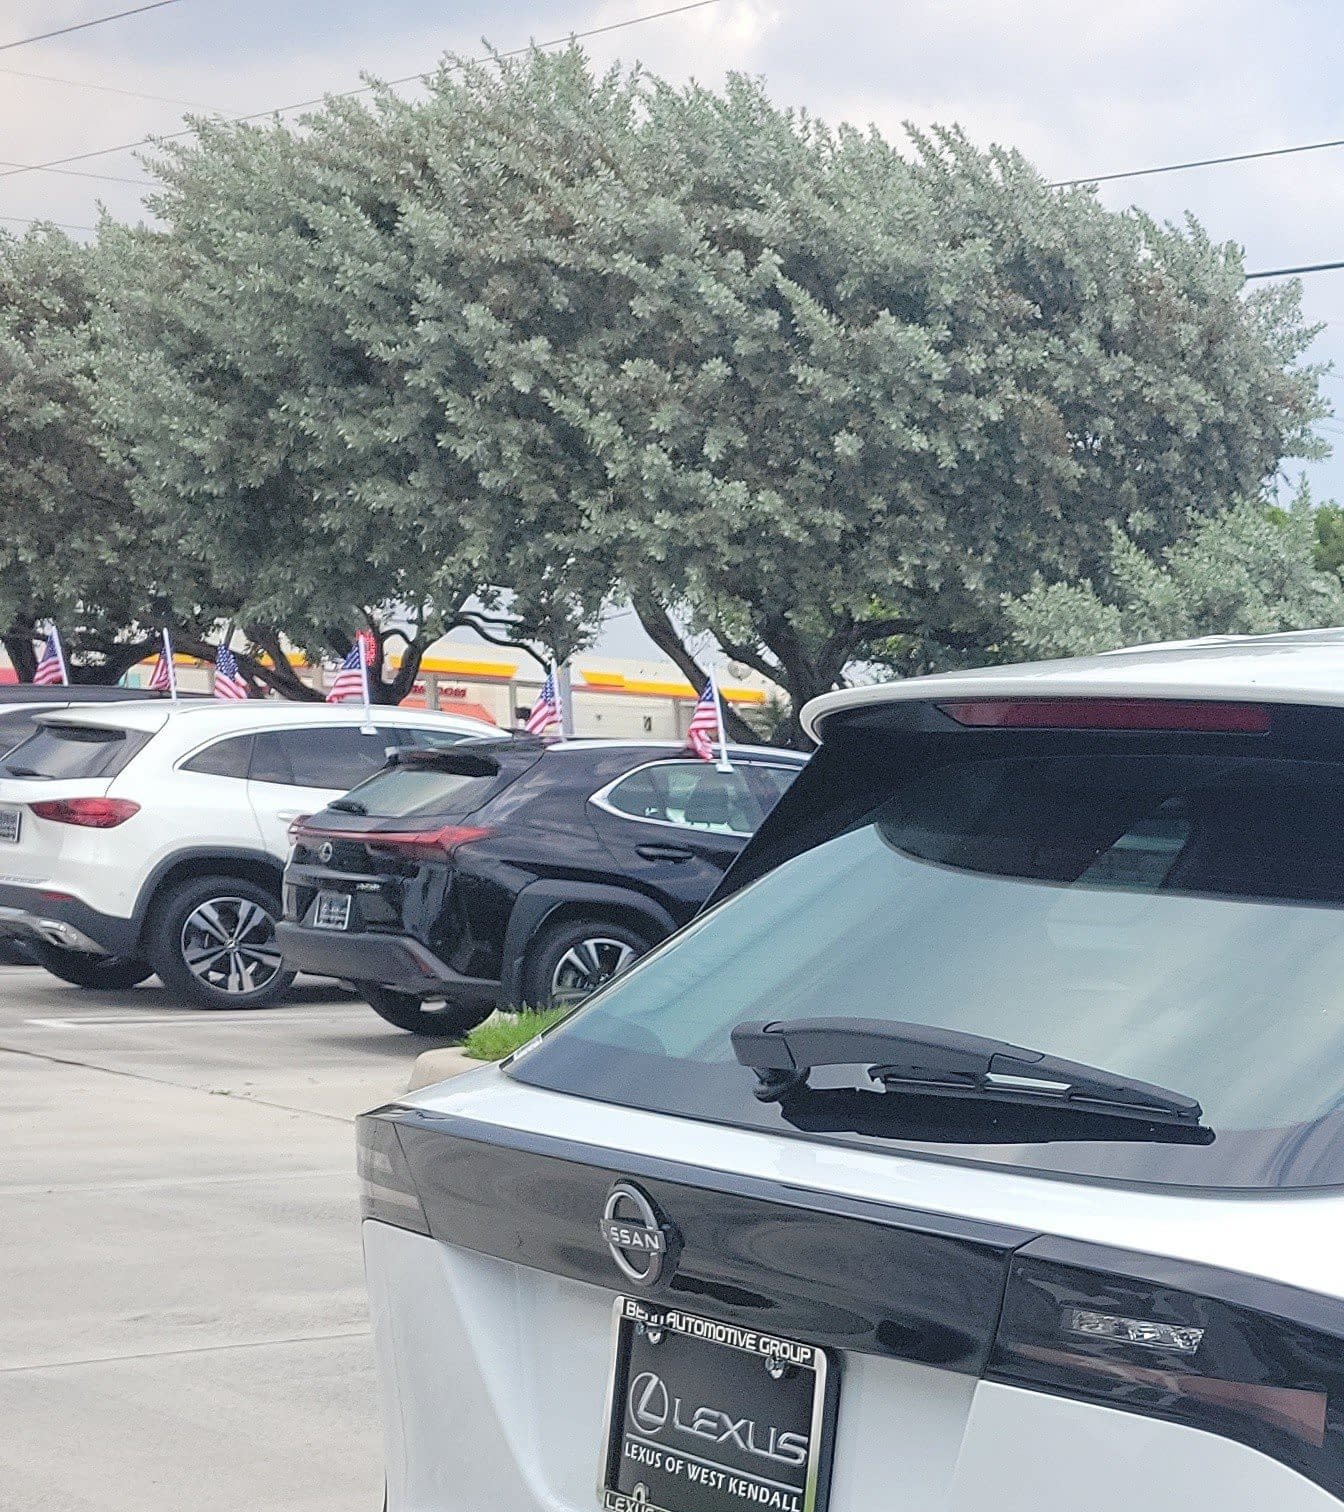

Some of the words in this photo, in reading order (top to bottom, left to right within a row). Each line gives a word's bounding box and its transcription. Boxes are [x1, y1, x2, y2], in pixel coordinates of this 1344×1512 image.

[603, 1224, 661, 1250] SSAN
[666, 1311, 758, 1351] AUTOMOTIVE
[759, 1336, 812, 1364] GROUP
[673, 1397, 809, 1466] LEXUS
[625, 1441, 662, 1467] LEXUS
[665, 1456, 684, 1475] OF
[687, 1463, 726, 1490] WEST
